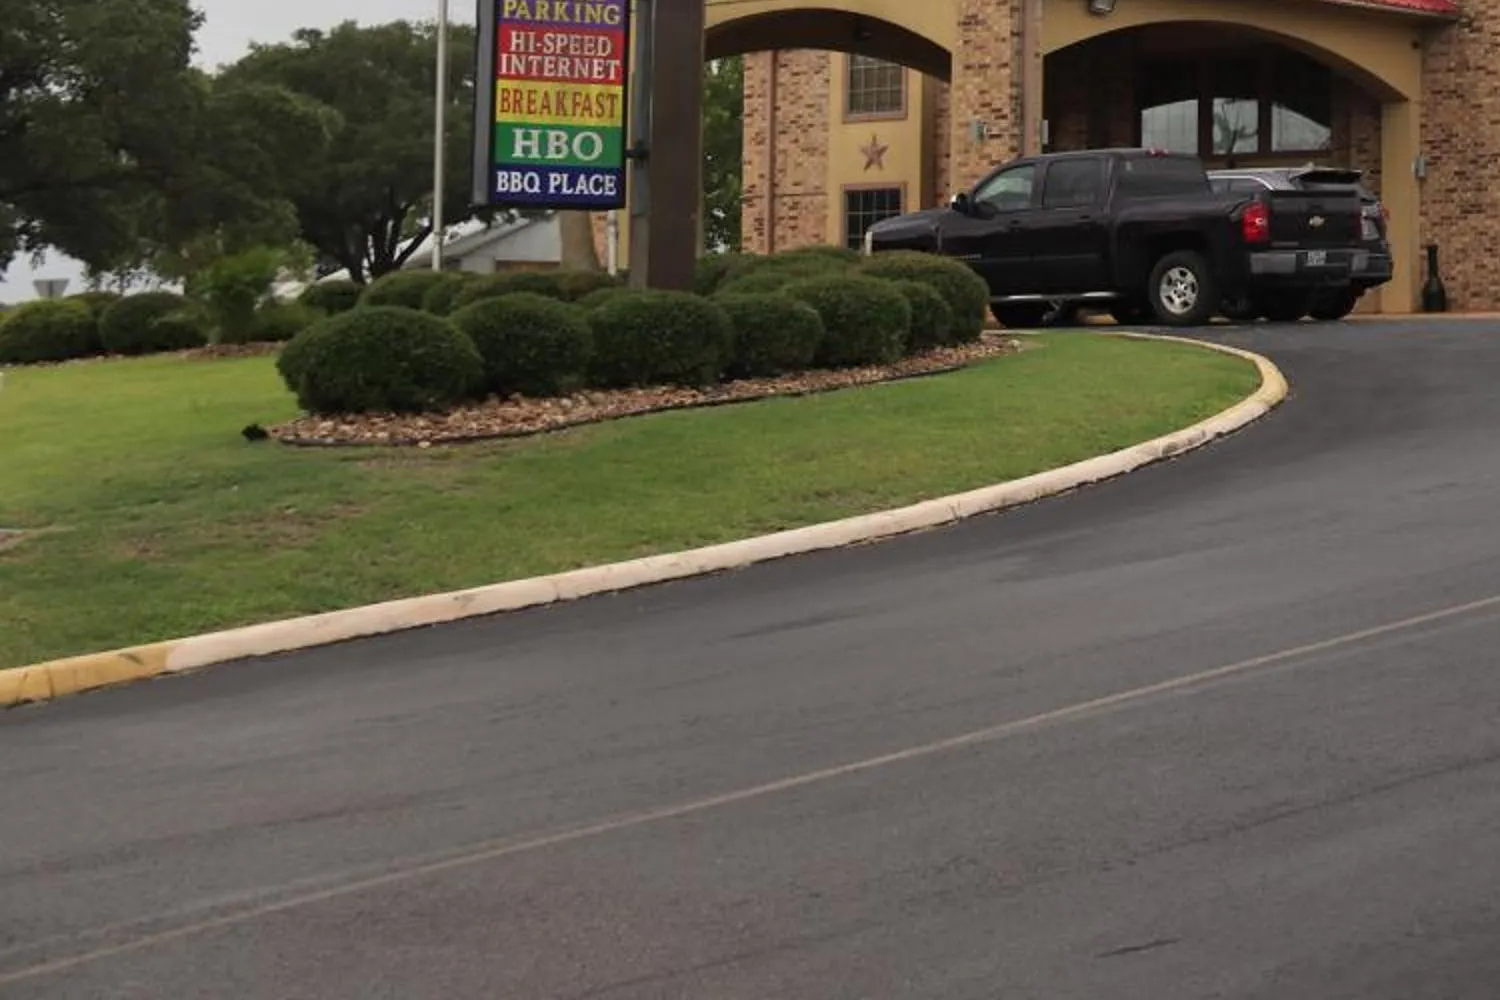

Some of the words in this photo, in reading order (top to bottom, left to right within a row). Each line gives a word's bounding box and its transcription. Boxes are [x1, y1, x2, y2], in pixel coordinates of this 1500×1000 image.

[510, 31, 612, 56] HI-SPEED
[500, 54, 621, 80] INTERNET
[500, 87, 619, 119] BREAKFAST
[512, 128, 603, 161] HBO
[496, 171, 541, 194] BBQ
[548, 172, 617, 196] PLACE
